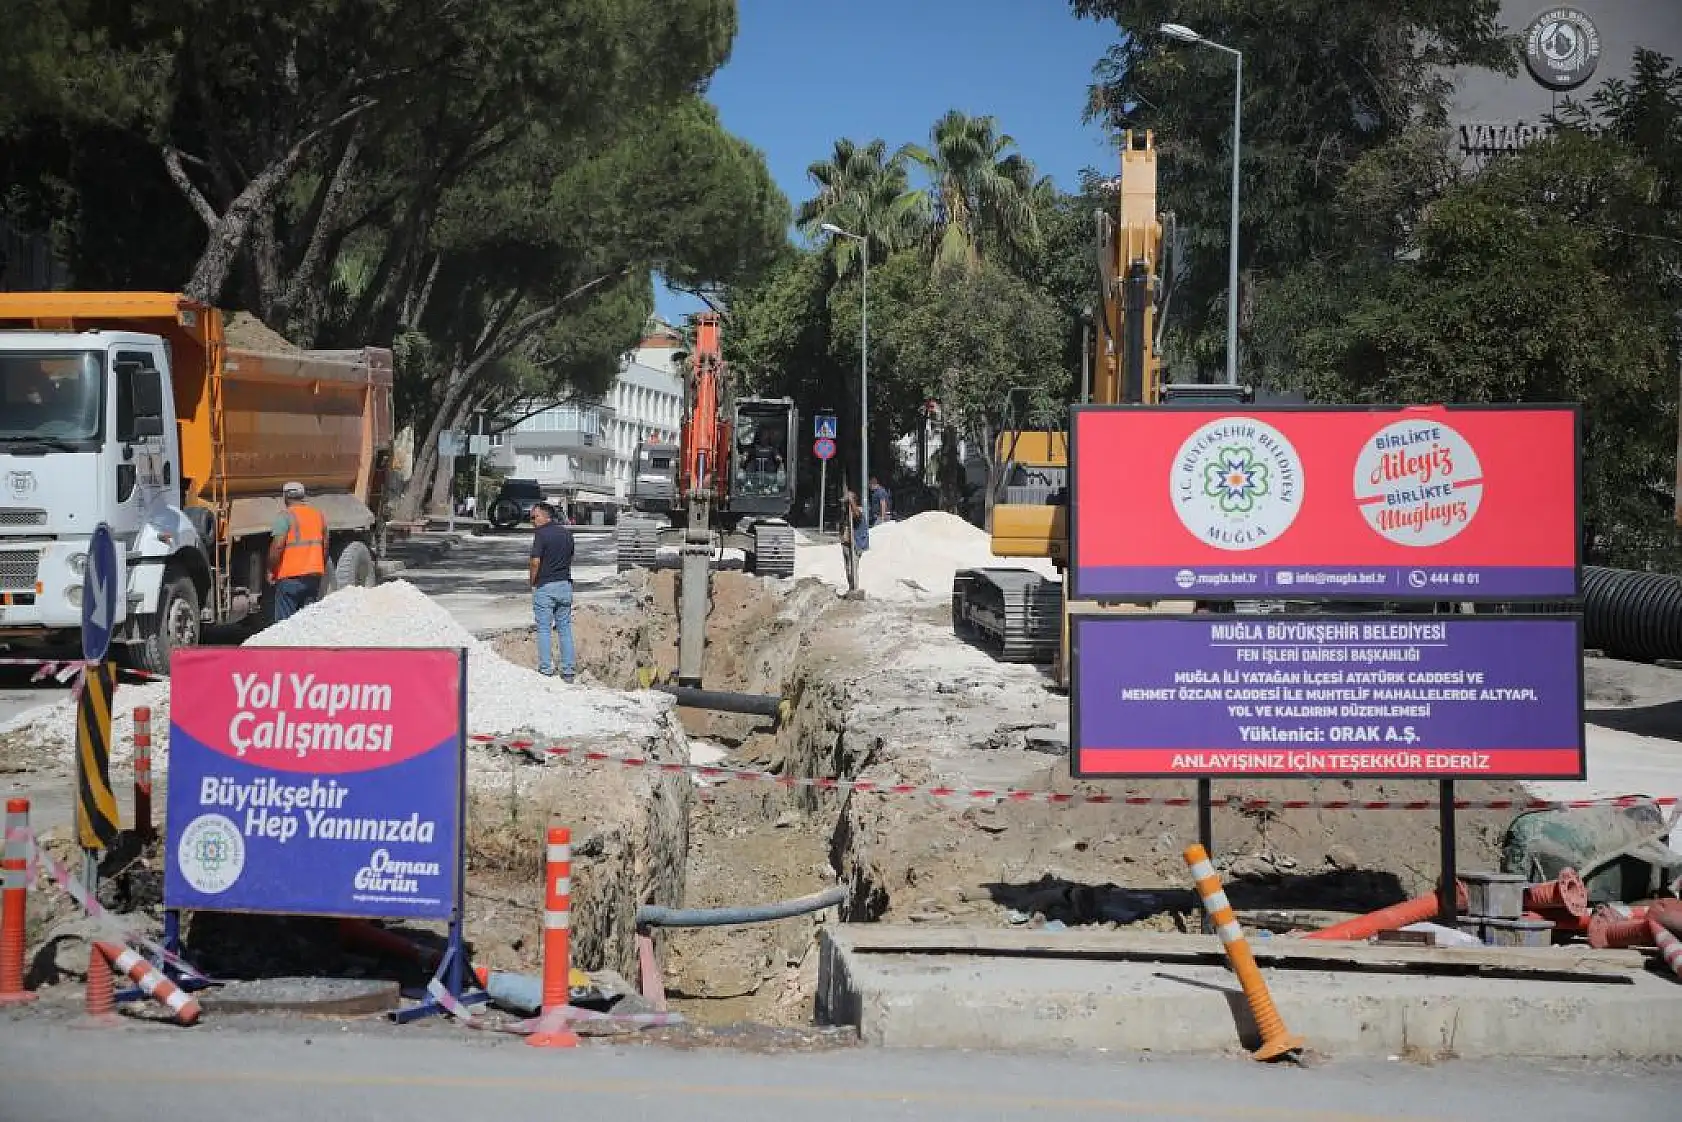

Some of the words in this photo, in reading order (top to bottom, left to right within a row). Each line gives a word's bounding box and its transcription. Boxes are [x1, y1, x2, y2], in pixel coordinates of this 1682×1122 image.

[1376, 427, 1441, 449] BİRLİKTE
[1370, 442, 1454, 485] Aileyiz
[1387, 483, 1452, 505] BİRLİKTE
[1206, 525, 1268, 544] MUĞLA
[1430, 571, 1448, 584] 444
[1211, 622, 1263, 641] MUĞLA
[1267, 622, 1359, 644] BÜYÜKŞEHİR
[1363, 621, 1446, 640] BELEDİYESİ
[1236, 648, 1259, 662] FEN
[1262, 647, 1300, 664] İŞLERİ
[1302, 647, 1348, 662] DAİRESİ
[1351, 647, 1420, 664] BAŞKANLIĞI
[1175, 670, 1220, 684] MUĞLA
[1223, 669, 1239, 683] İLİ
[1242, 670, 1300, 684] YATAĞAN
[1303, 670, 1343, 686] İLÇESİ
[1346, 670, 1405, 685] ATATÜRK
[1408, 670, 1464, 684] CADDESİ
[1466, 671, 1484, 684] VE
[231, 672, 282, 708] Yol
[288, 672, 393, 717] Yapım
[1122, 689, 1176, 701] MEHMET
[1179, 686, 1222, 701] ÖZCAN
[1224, 686, 1281, 701] CADDESİ
[1284, 686, 1304, 700] İLE
[1307, 686, 1370, 701] MUHTELİF
[1373, 688, 1477, 701] MAHALLELERDE
[1228, 705, 1253, 717] YOL
[1255, 705, 1273, 717] VE
[1275, 705, 1338, 717] KALDIRIM
[1341, 703, 1431, 718] DÜZENLEMESİ
[228, 711, 394, 758] Çalışması
[1239, 725, 1325, 743] Yüklenici:
[1329, 725, 1380, 742] ORAK
[1385, 725, 1421, 745] A.Ş.
[1171, 753, 1284, 771] ANLAYIŞINIZ
[1288, 752, 1326, 770] İÇİN
[1328, 752, 1421, 771] TEŞEKKÜR
[1426, 751, 1490, 769] EDERİZ
[199, 776, 349, 812] Büyükşehir
[244, 808, 299, 843] Hep
[305, 811, 435, 843] Yanınızda
[370, 848, 440, 875] Osman
